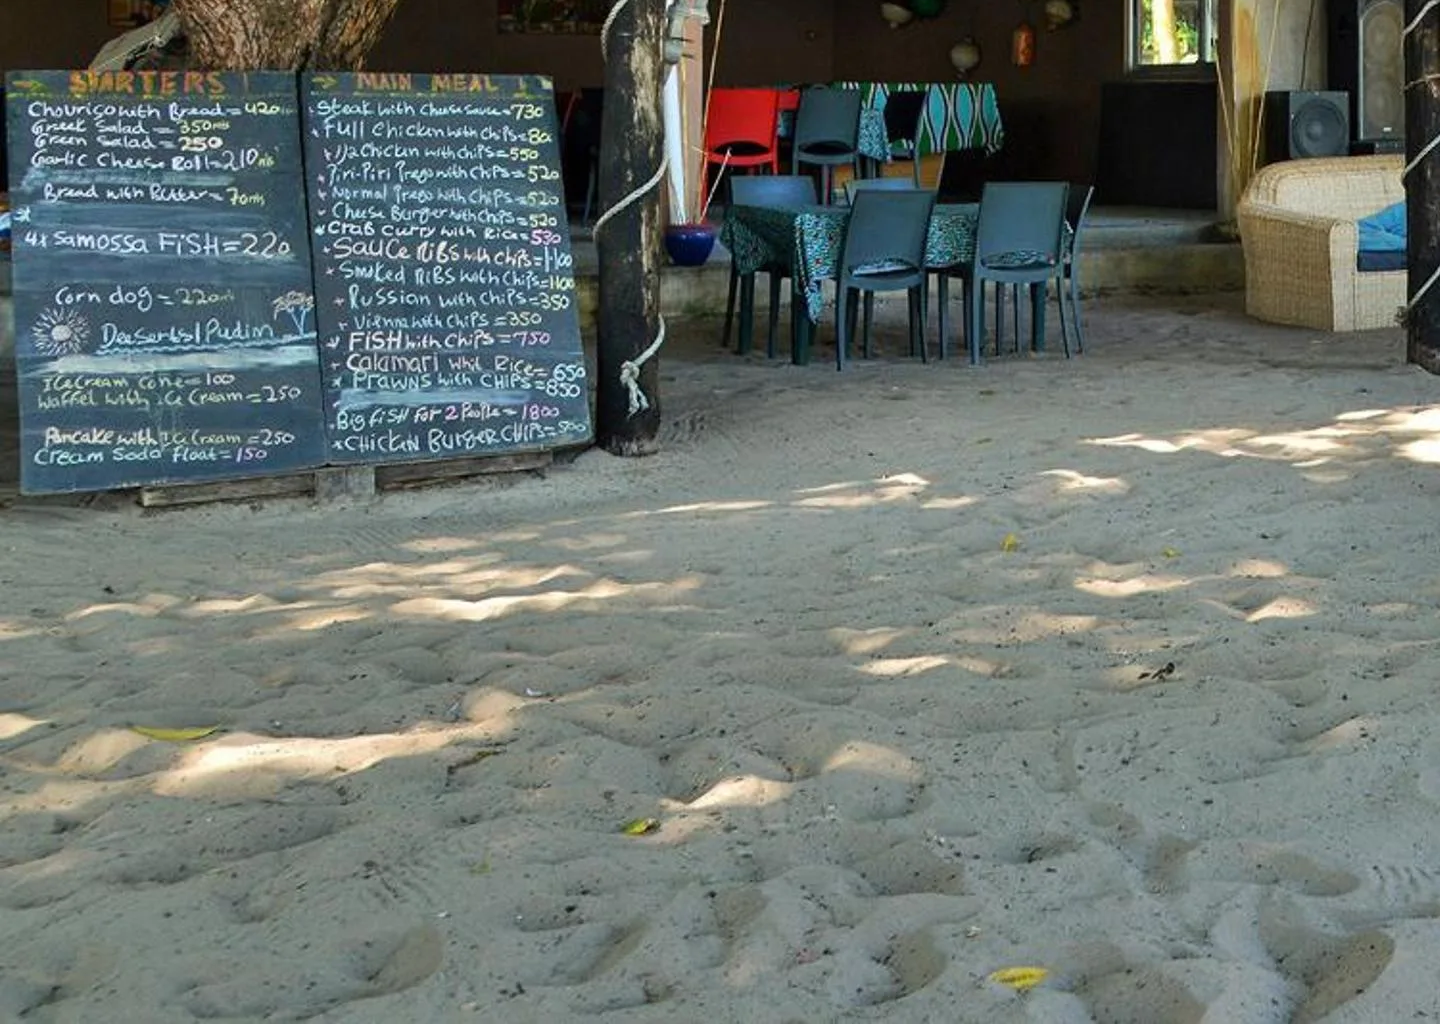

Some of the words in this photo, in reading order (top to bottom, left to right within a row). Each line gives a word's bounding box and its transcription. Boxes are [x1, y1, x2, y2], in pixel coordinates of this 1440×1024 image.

[68, 69, 227, 95] STARTERS
[357, 73, 411, 91] MAIN
[432, 74, 499, 92] MEAL
[169, 102, 223, 121] Bread
[317, 97, 375, 116] Steak
[377, 101, 415, 116] with
[31, 118, 87, 135] Greek
[95, 119, 150, 135] Salad
[34, 133, 88, 151] Green
[96, 135, 157, 149] Salad
[44, 182, 98, 203] Bread
[106, 186, 144, 200] with
[391, 204, 448, 225] Burger
[440, 226, 477, 239] with
[55, 287, 100, 305] Corn
[109, 285, 152, 312] dog
[439, 291, 477, 308] with
[187, 388, 243, 405] Cream
[445, 405, 459, 420] 2
[116, 428, 159, 446] with
[34, 448, 104, 465] Cream
[112, 447, 162, 461] Soda
[236, 448, 267, 463] 150
